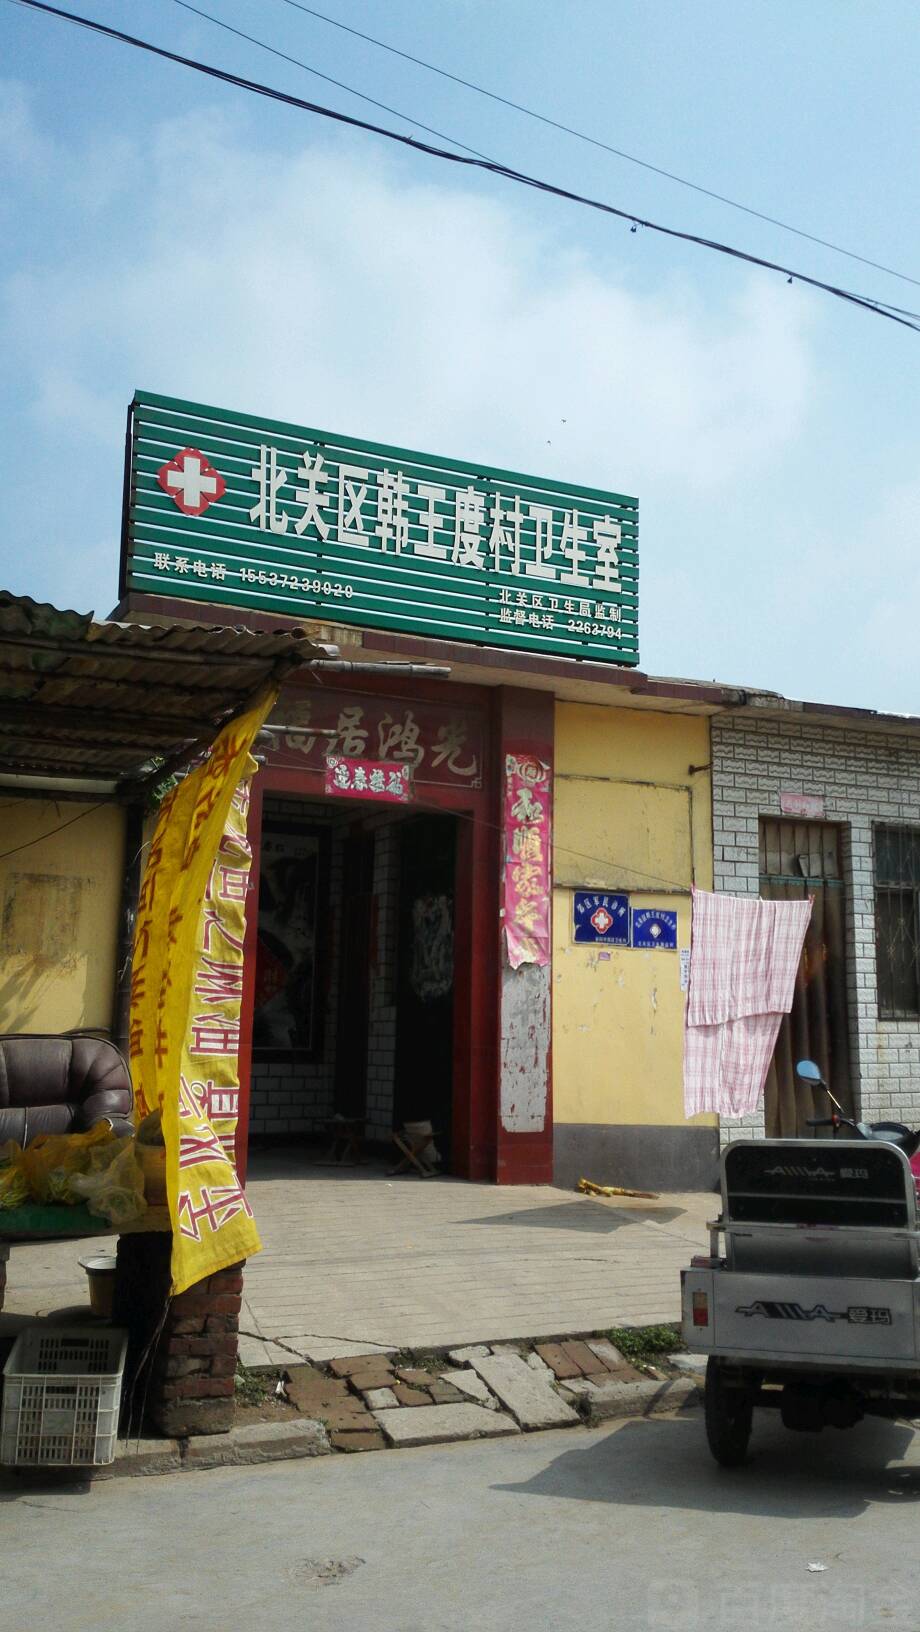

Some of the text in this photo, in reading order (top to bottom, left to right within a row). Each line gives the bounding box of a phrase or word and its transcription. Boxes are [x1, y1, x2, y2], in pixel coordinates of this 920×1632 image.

[249, 443, 622, 593] 北关区韩王度村卫生室
[153, 552, 354, 599] 联系电话 15537239020
[499, 588, 622, 622] 北关区卫生局监制
[499, 607, 622, 640] 监督电话 2263794
